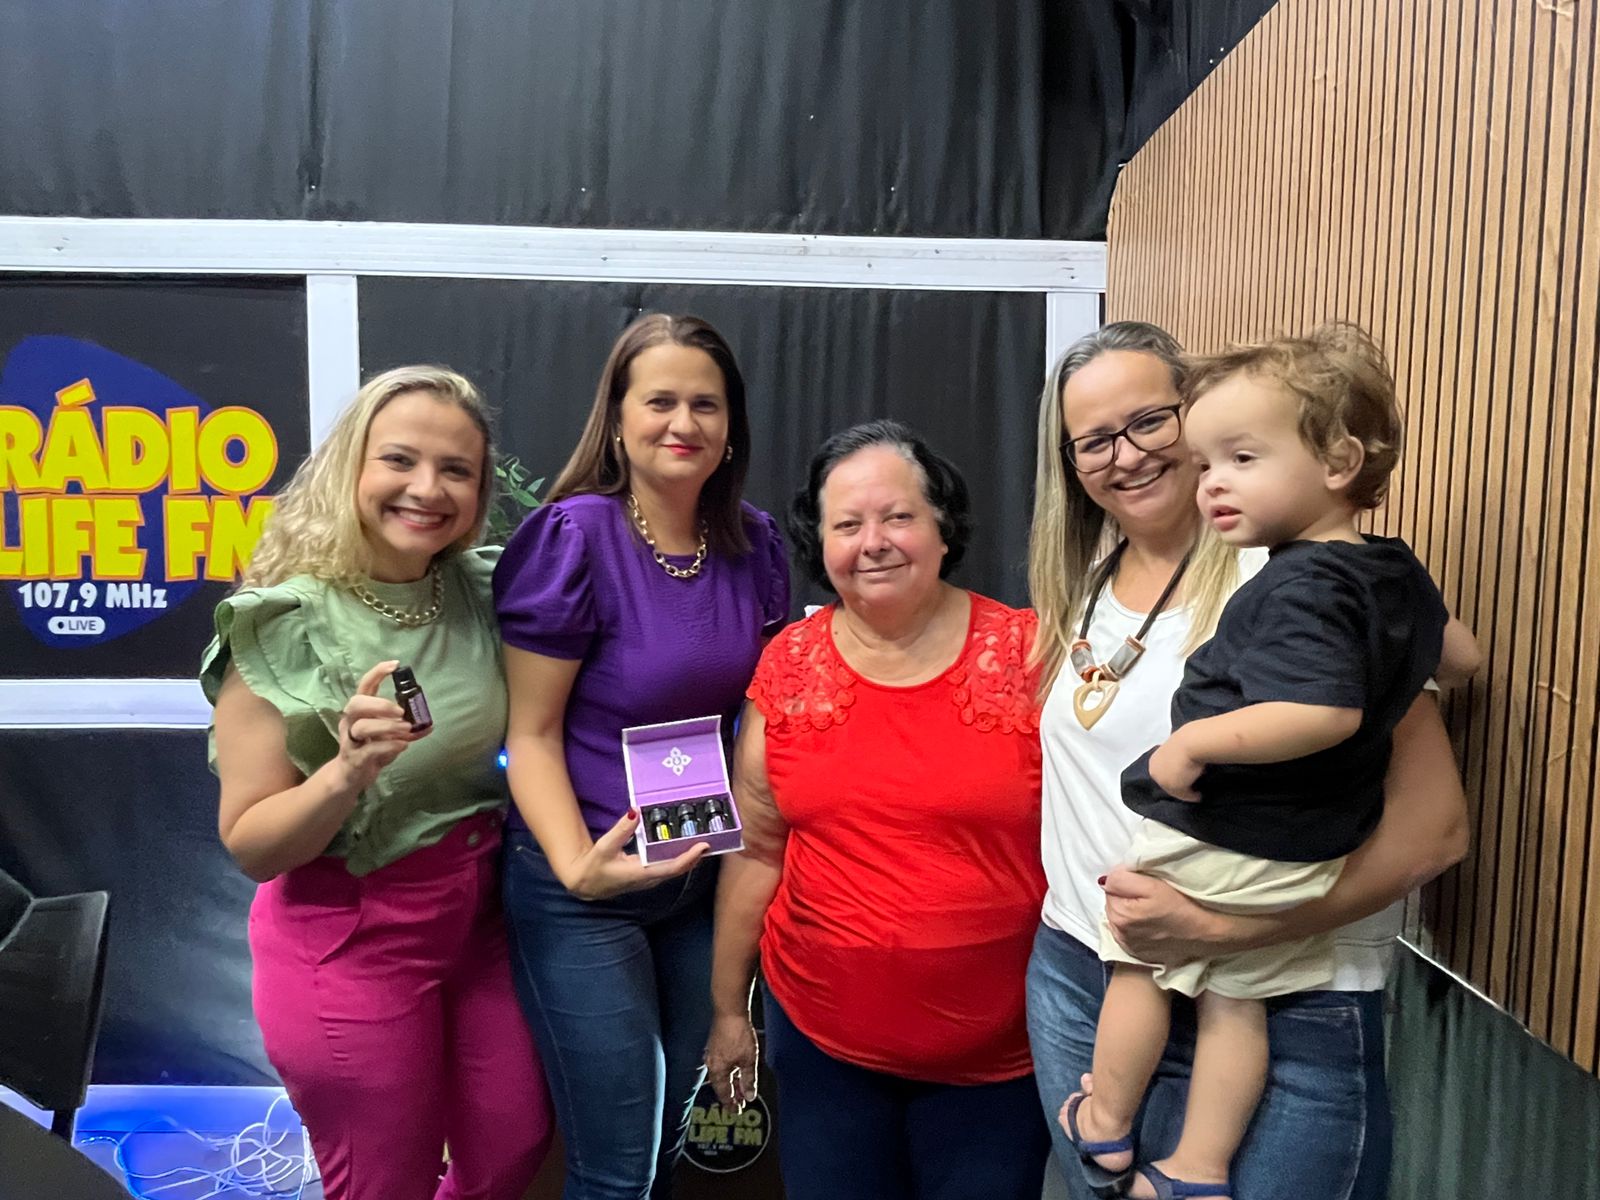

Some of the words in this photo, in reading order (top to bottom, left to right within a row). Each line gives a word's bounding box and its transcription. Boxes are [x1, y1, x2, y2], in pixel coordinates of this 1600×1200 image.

[0, 378, 279, 494] RÁDIO
[18, 582, 98, 612] 107,9
[105, 583, 168, 608] MHz
[68, 620, 97, 631] LIVE
